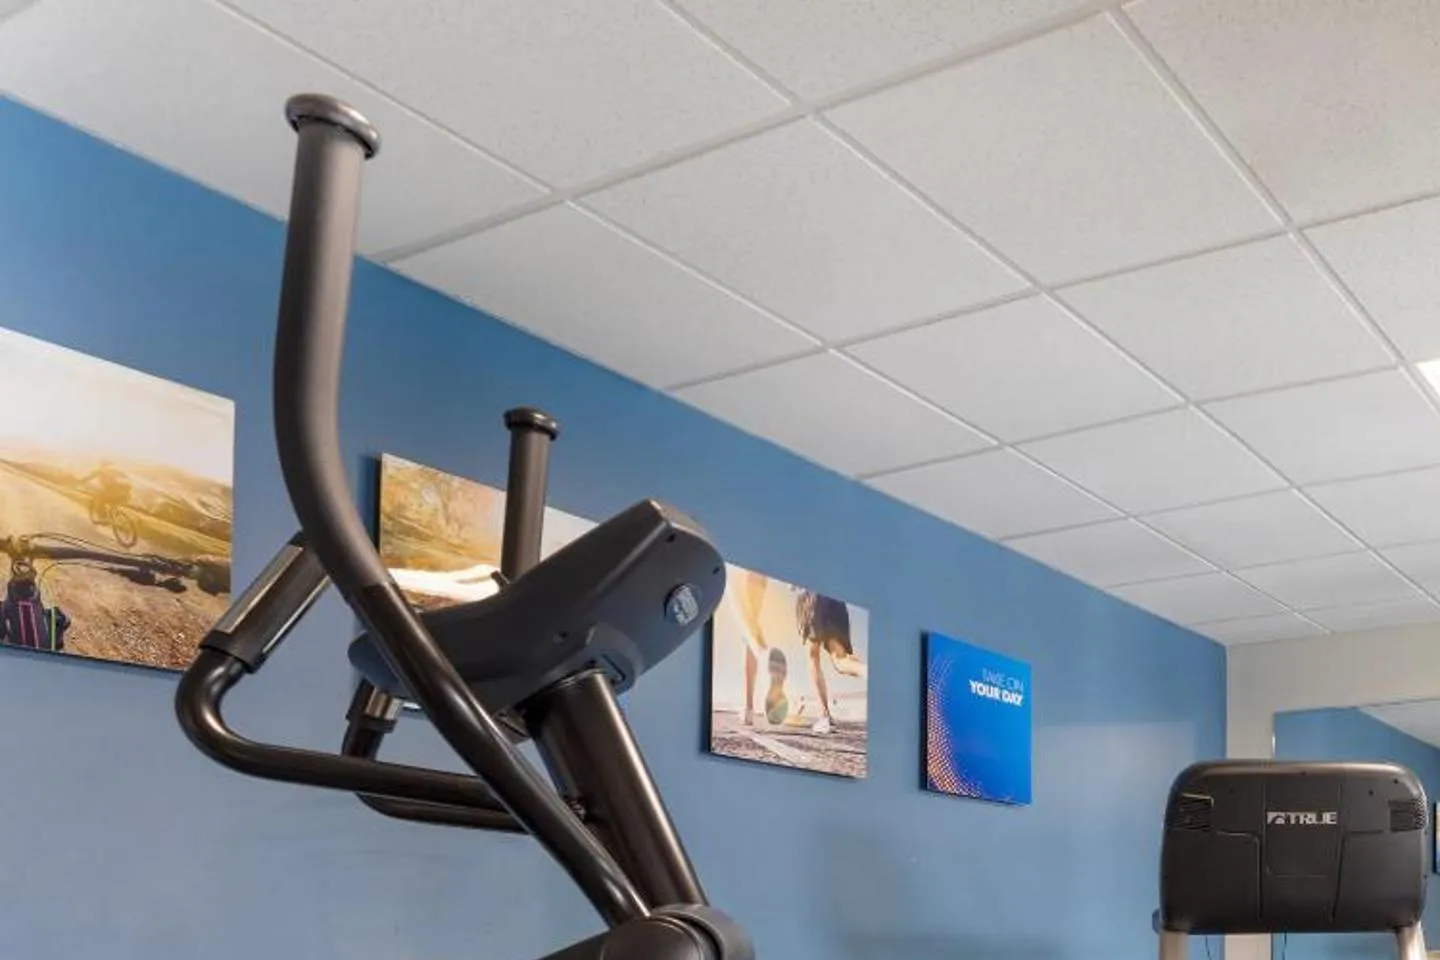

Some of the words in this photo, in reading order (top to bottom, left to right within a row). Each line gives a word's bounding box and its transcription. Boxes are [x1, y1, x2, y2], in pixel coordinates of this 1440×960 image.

[982, 668, 1006, 687] TAKE
[1006, 677, 1024, 692] ON
[969, 680, 1000, 700] YOUR
[1002, 689, 1023, 706] DAY
[1289, 811, 1338, 825] TRUE
